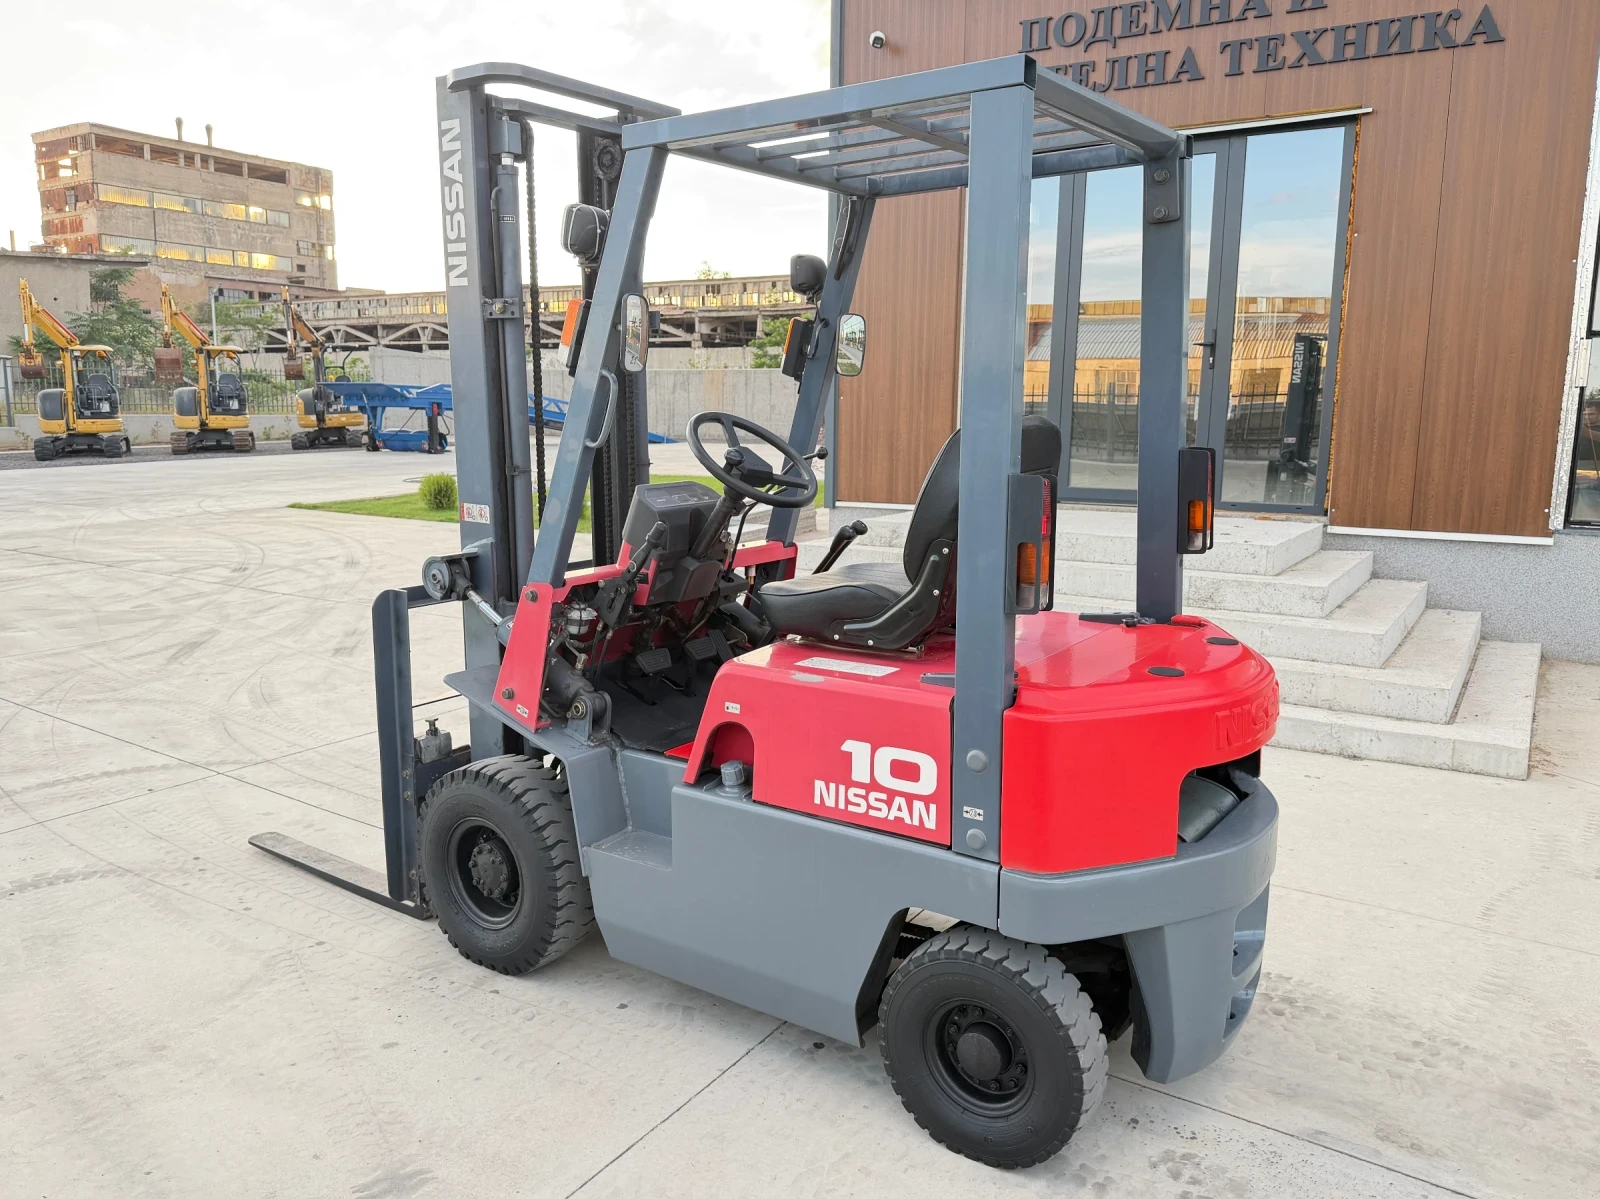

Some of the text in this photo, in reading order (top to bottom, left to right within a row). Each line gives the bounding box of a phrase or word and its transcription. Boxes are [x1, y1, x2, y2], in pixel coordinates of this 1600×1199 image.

[1018, 0, 1272, 53] ПОДЕМНА
[1045, 4, 1505, 92] ЕЛНА ТЕХНИКА
[441, 118, 468, 287] NISSAN
[840, 739, 937, 796] 10
[814, 779, 936, 830] NISSAN
